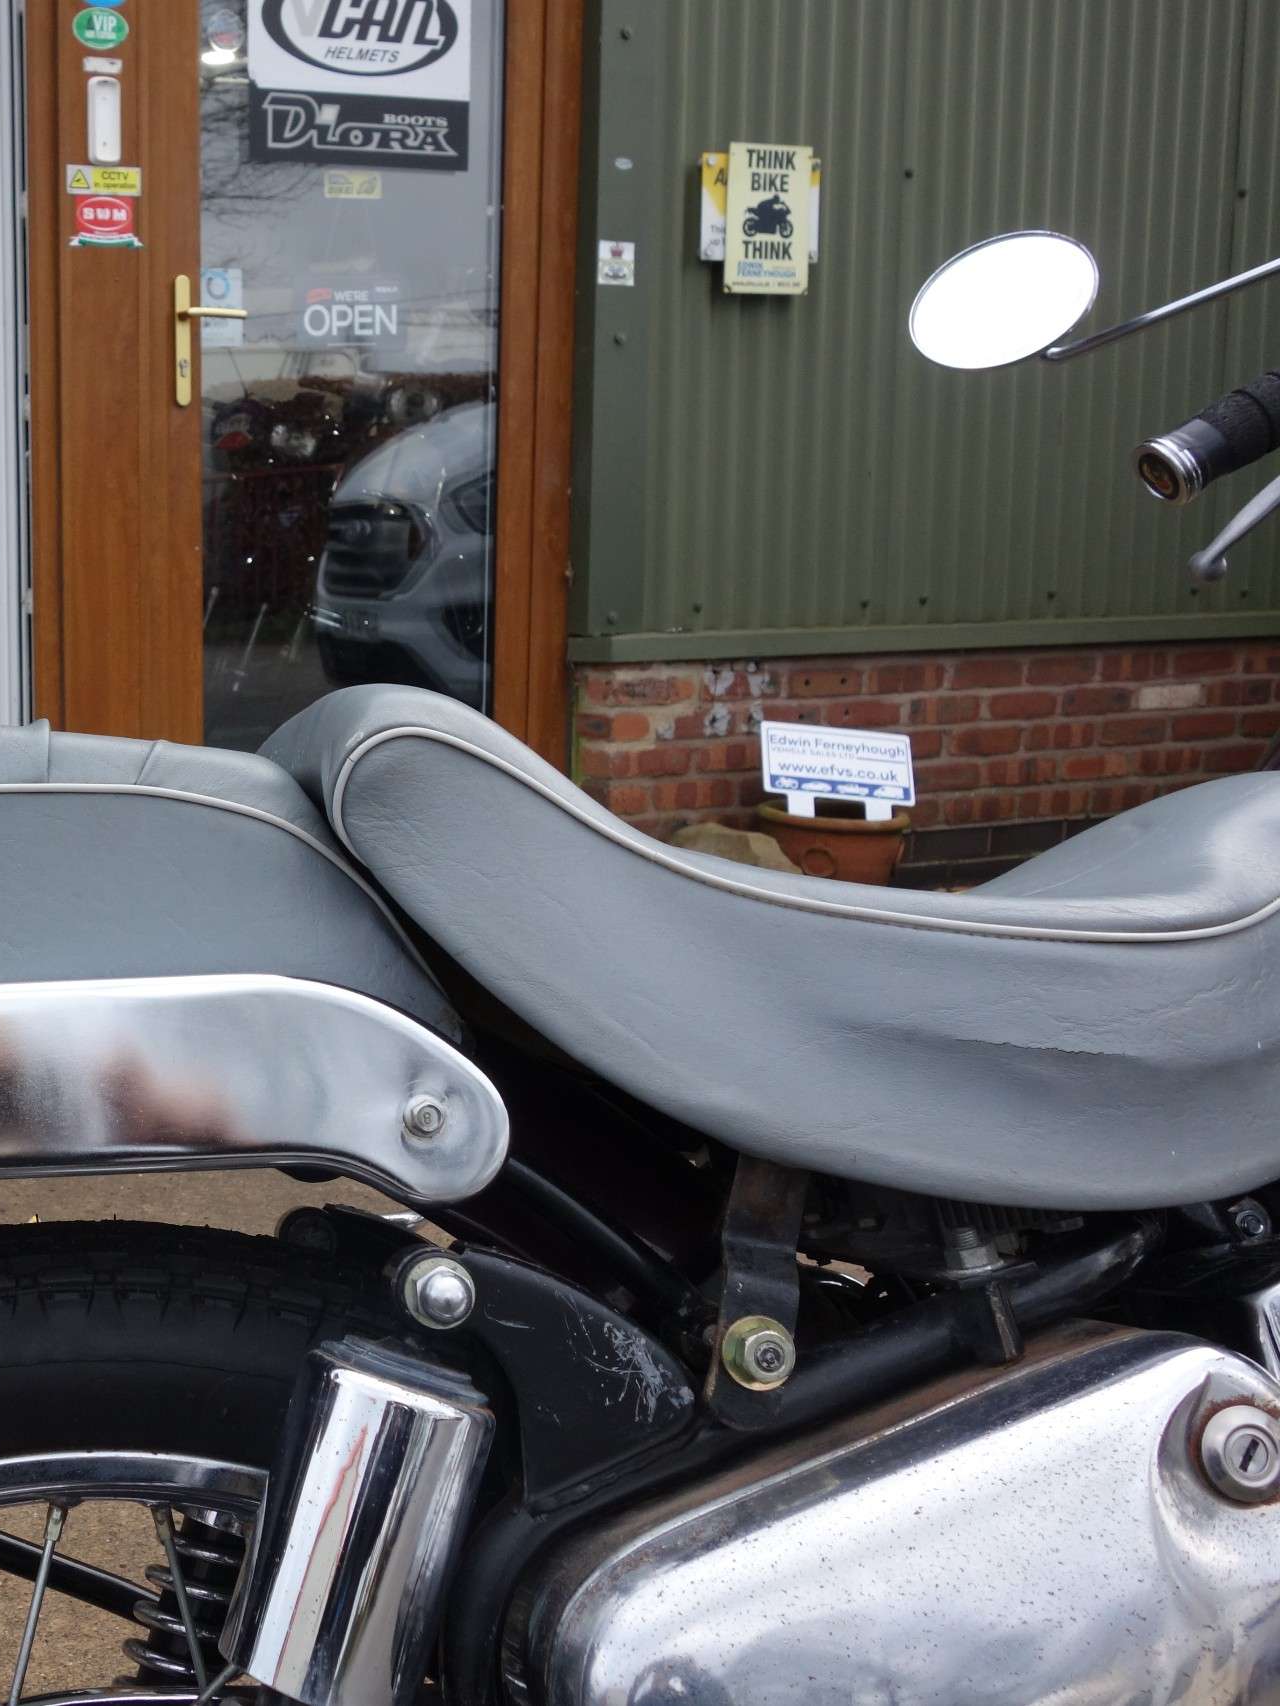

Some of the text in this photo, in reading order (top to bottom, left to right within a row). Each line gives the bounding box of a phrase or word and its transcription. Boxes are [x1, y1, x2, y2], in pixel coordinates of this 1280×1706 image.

[324, 46, 400, 64] HELMETS
[383, 113, 449, 127] BOOTS
[747, 149, 797, 171] THINK
[101, 170, 128, 180] CCTV
[751, 172, 790, 193] BIKE
[742, 240, 793, 261] THINK
[303, 304, 397, 337] OPEN
[770, 734, 905, 759] Edwin Ferneyhough
[778, 761, 899, 782] www.efvs.co.uk
